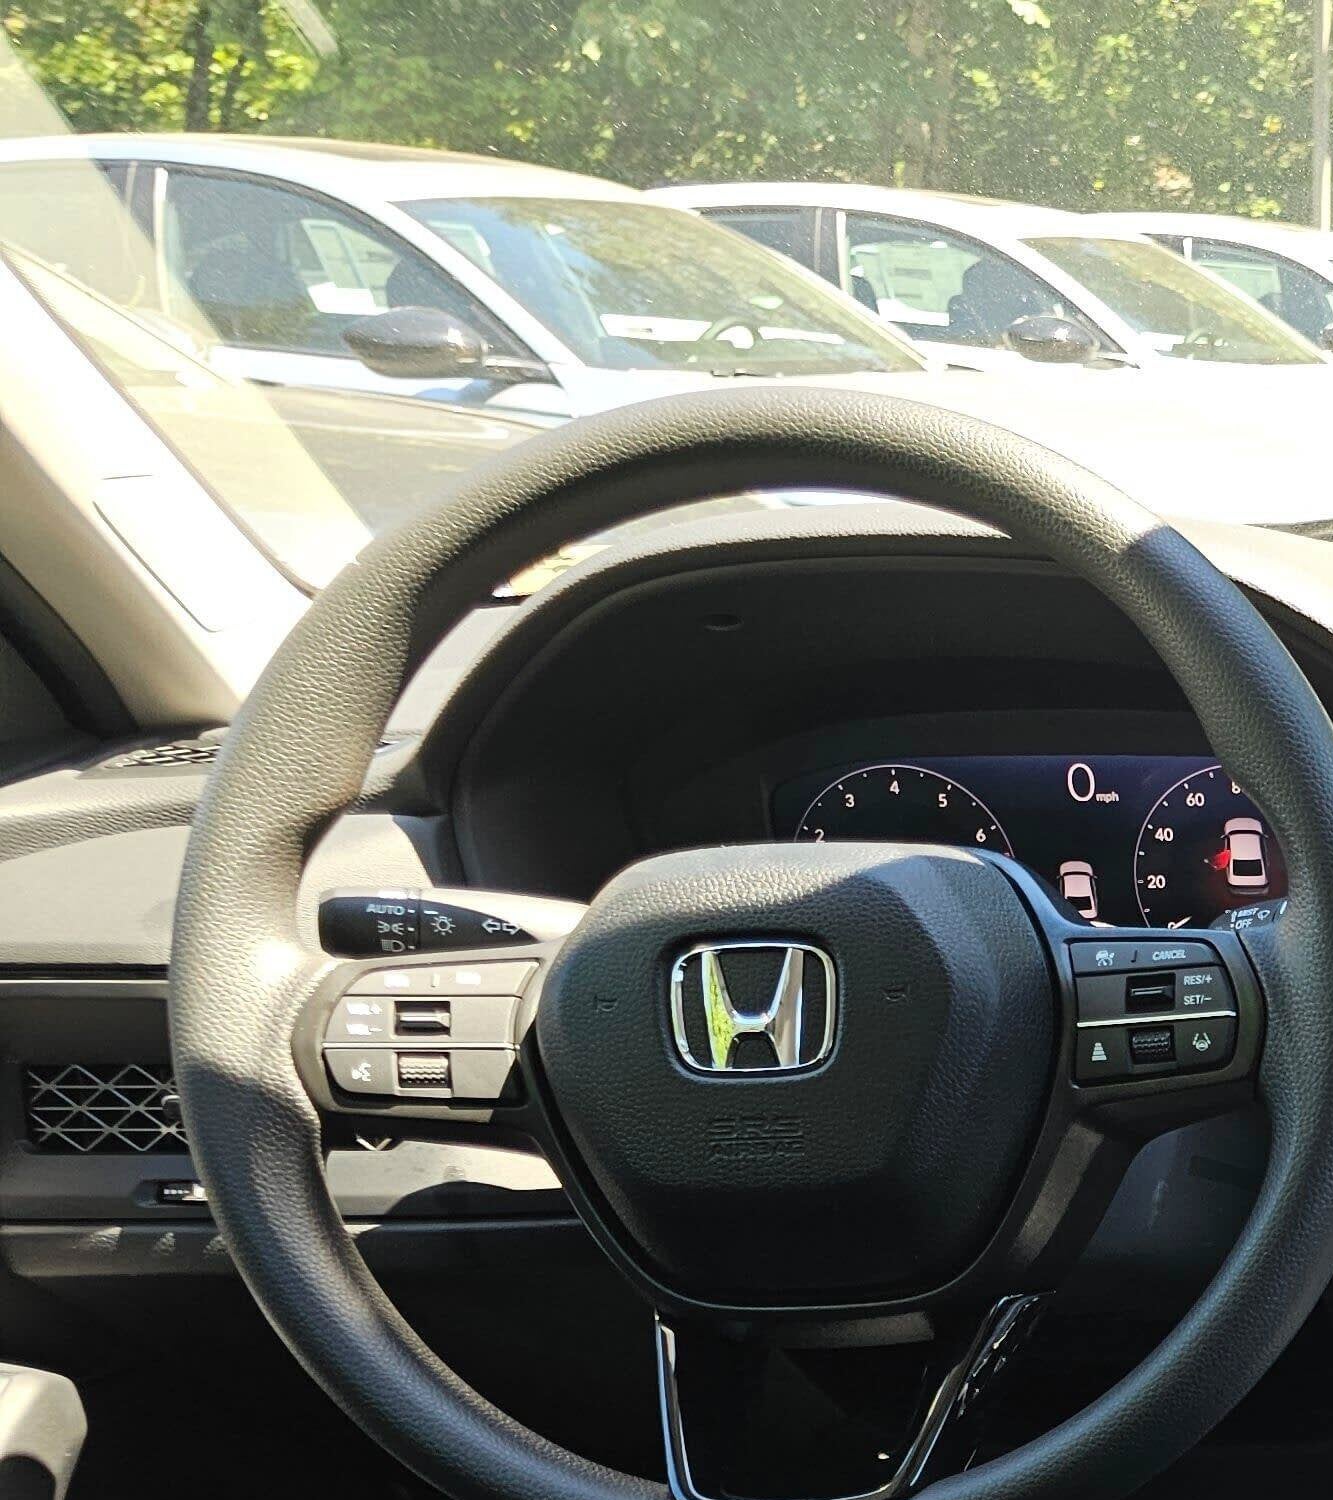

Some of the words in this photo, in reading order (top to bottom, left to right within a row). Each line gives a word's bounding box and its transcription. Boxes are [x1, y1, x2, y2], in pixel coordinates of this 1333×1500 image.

[889, 780, 901, 795] 4
[1067, 762, 1096, 802] 0
[1096, 791, 1120, 803] mph
[844, 793, 855, 808] 3
[938, 793, 948, 808] 5
[1186, 792, 1205, 807] 60
[814, 828, 825, 843] 2
[975, 828, 986, 842] 6
[1154, 828, 1174, 842] 40
[1147, 875, 1166, 889] 20
[365, 903, 405, 916] AUTO
[1235, 919, 1253, 930] OFF
[1152, 950, 1187, 961] CANCEL
[1183, 974, 1213, 985] RES/+
